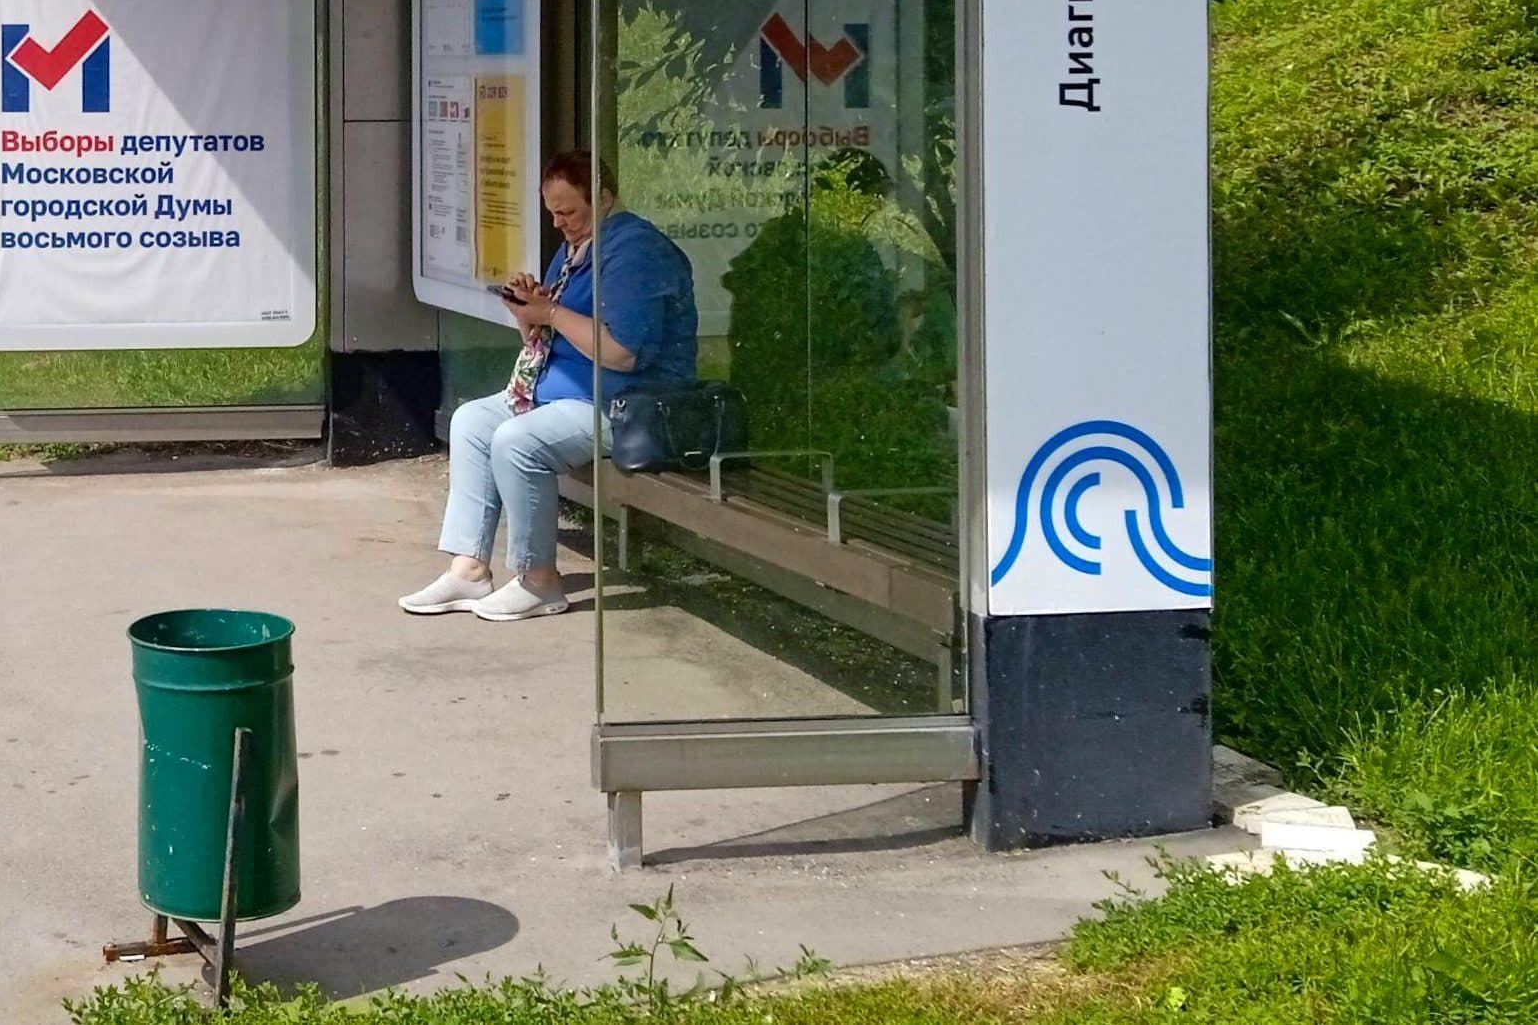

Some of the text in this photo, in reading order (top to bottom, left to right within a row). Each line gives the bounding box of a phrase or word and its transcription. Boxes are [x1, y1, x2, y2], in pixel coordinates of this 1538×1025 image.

[1, 130, 265, 157] Выборы депутатов
[1, 161, 174, 184] Московской
[1, 194, 233, 222] городской Думы
[0, 229, 241, 249] восьмого созыва
